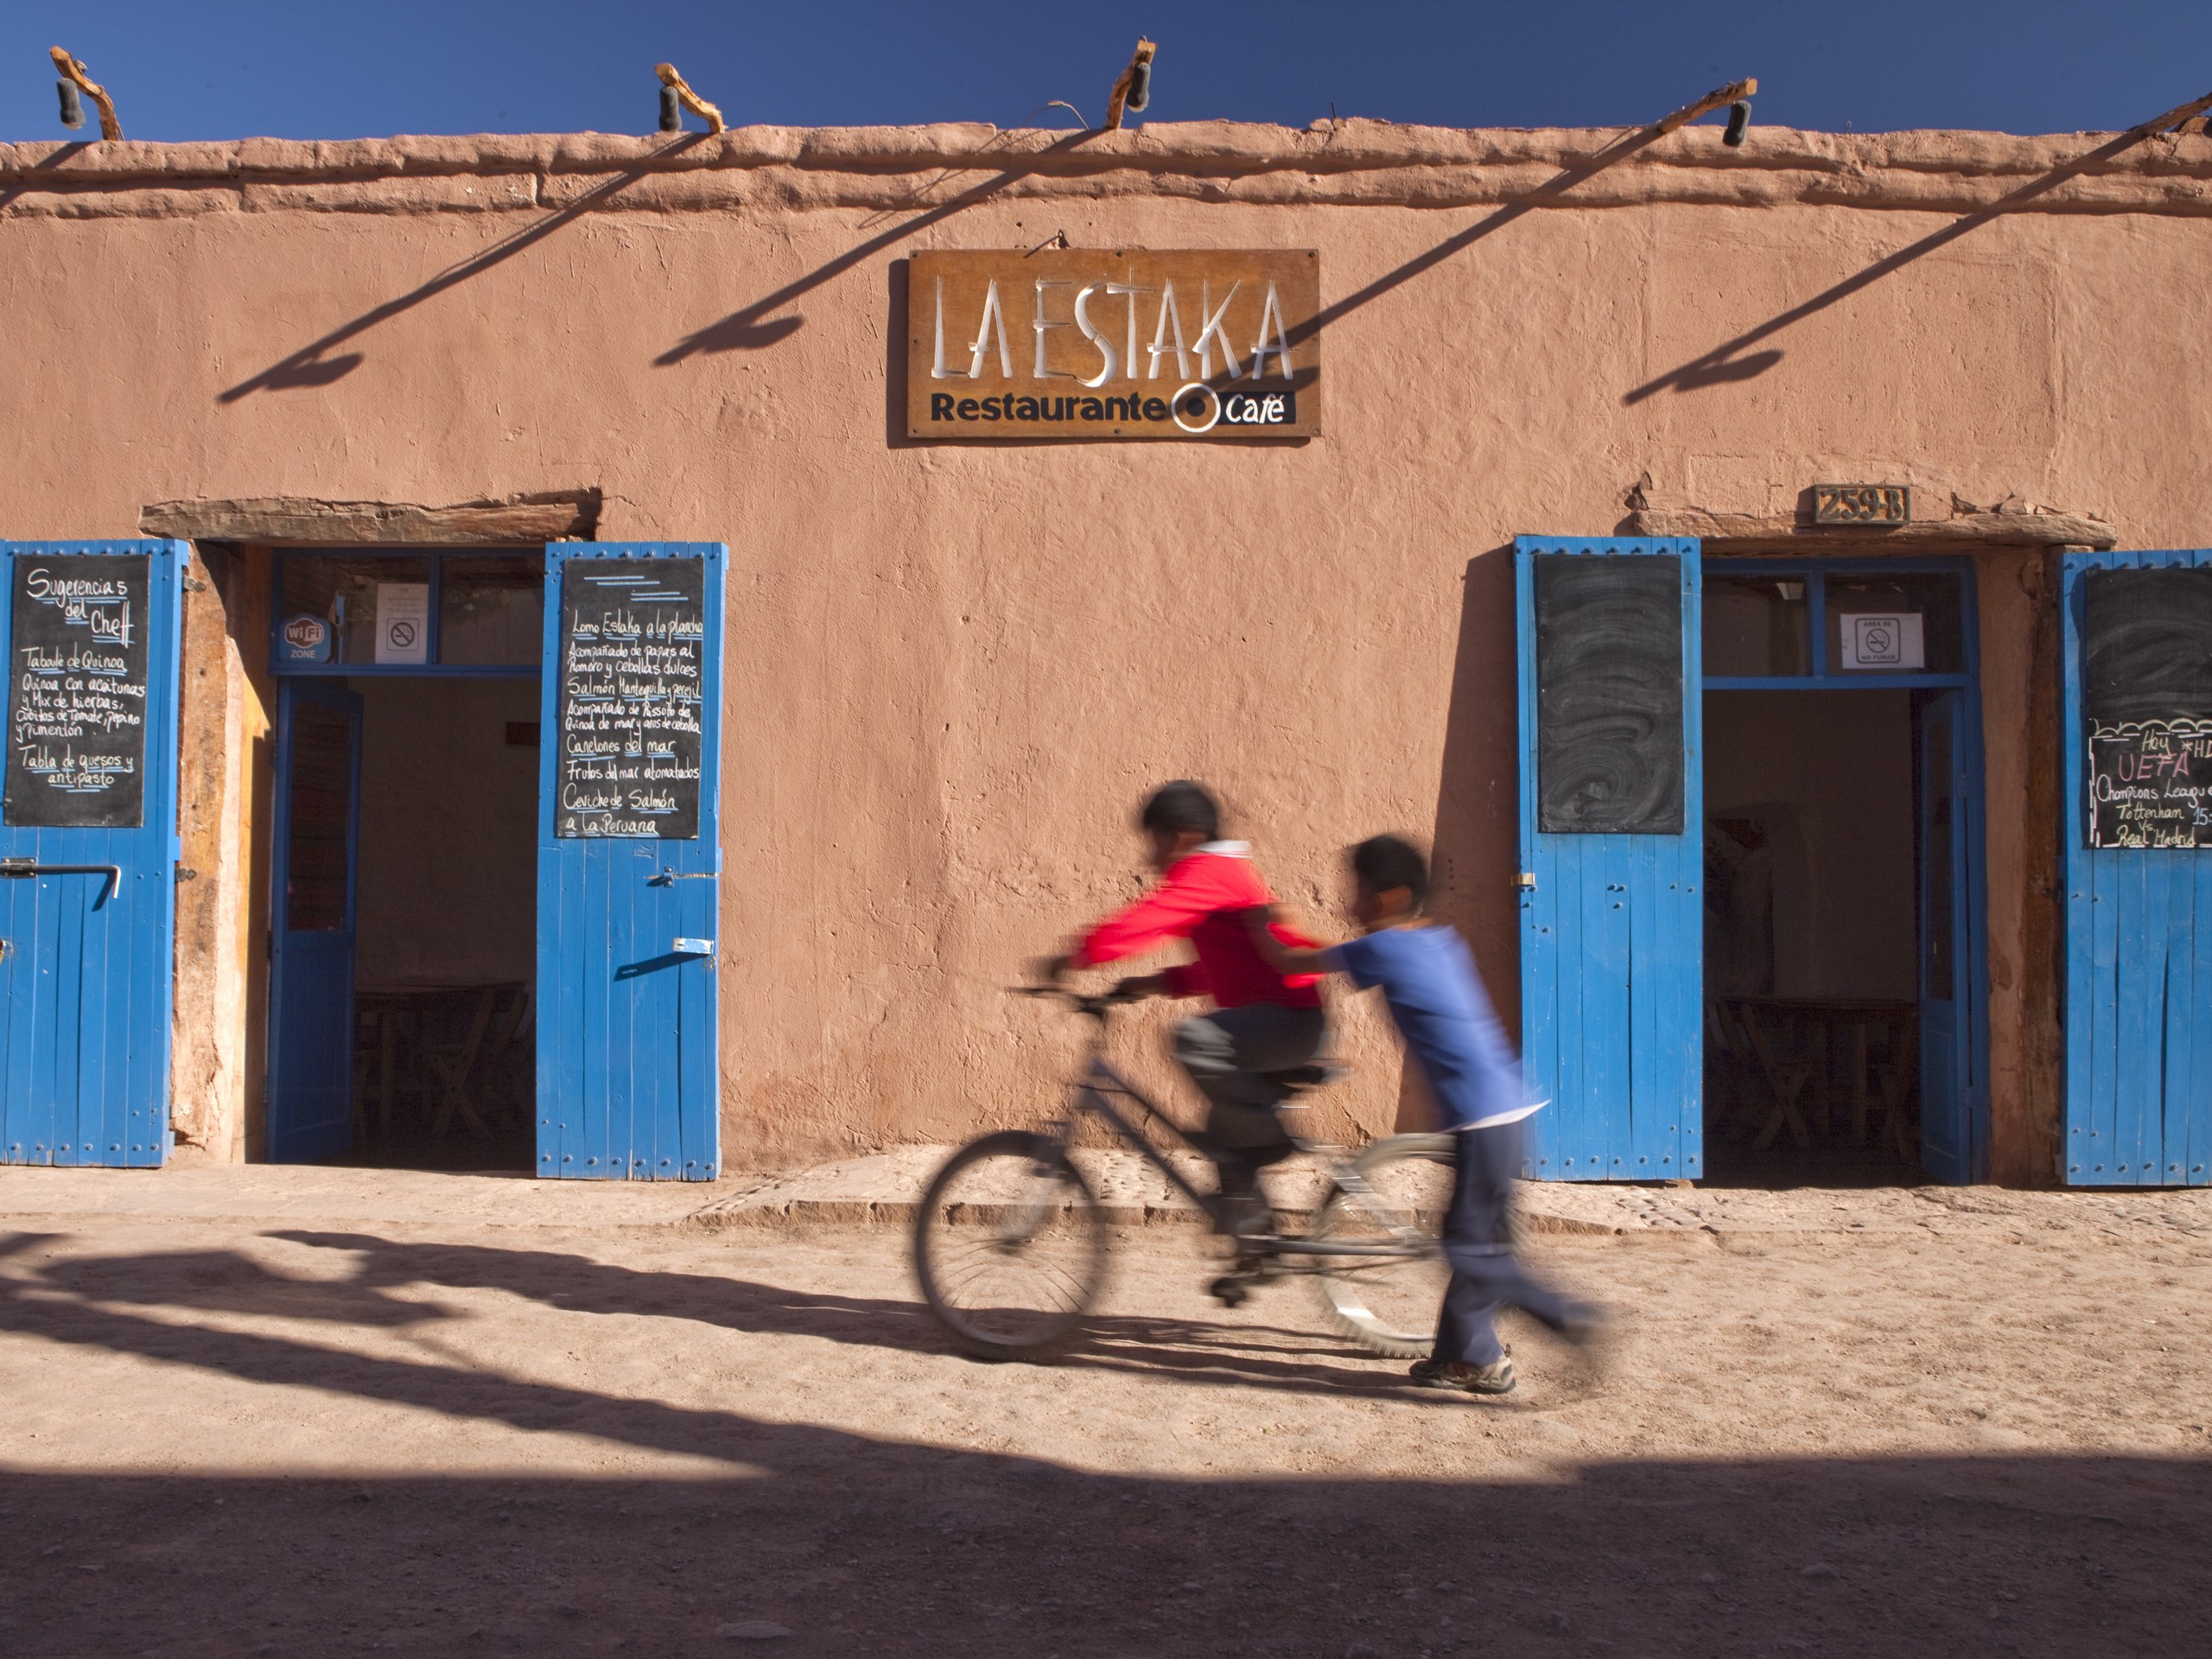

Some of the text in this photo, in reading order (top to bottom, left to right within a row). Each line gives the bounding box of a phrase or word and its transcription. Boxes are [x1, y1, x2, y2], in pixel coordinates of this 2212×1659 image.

[931, 266, 1300, 388] LA ESTAKA
[930, 391, 1166, 422] Restaurante
[27, 569, 128, 608] Sugerencias
[65, 598, 88, 618] del
[572, 608, 600, 633] Lomo
[646, 623, 654, 634] a
[656, 608, 666, 633] la
[667, 611, 703, 645] plancha
[67, 641, 80, 668] de
[82, 650, 128, 671] Quinoa
[290, 650, 316, 658] ZONE
[631, 640, 642, 657] de
[644, 645, 677, 666] papas
[679, 640, 695, 658] al
[606, 663, 613, 679] y
[663, 656, 697, 677] dulces
[22, 673, 60, 691] Quinoa
[88, 677, 146, 697] aceitunas
[567, 675, 615, 695] Salmón
[665, 686, 672, 705] y
[671, 680, 701, 704] perejil
[21, 694, 29, 710] y
[32, 691, 51, 708] Mix
[53, 692, 68, 708] de
[628, 700, 639, 715] de
[56, 709, 68, 722] de
[565, 715, 702, 736] Quinoa de mar y aros de cebolla
[16, 723, 23, 743] y
[567, 730, 677, 753] Canelones del mar
[2141, 728, 2171, 759] Hoy
[18, 743, 135, 773] Tabla de quesos y
[566, 757, 700, 781] Frutos del mar atomatados
[2119, 751, 2190, 782] UEFA
[48, 765, 115, 789] antipasto
[2095, 773, 2159, 804] Champions
[563, 782, 677, 810] Ceviche de Salmón
[2115, 801, 2185, 820] Tottenham
[566, 817, 577, 831] a
[600, 813, 657, 833] Peruana
[2116, 824, 2196, 846] Real Madrid
